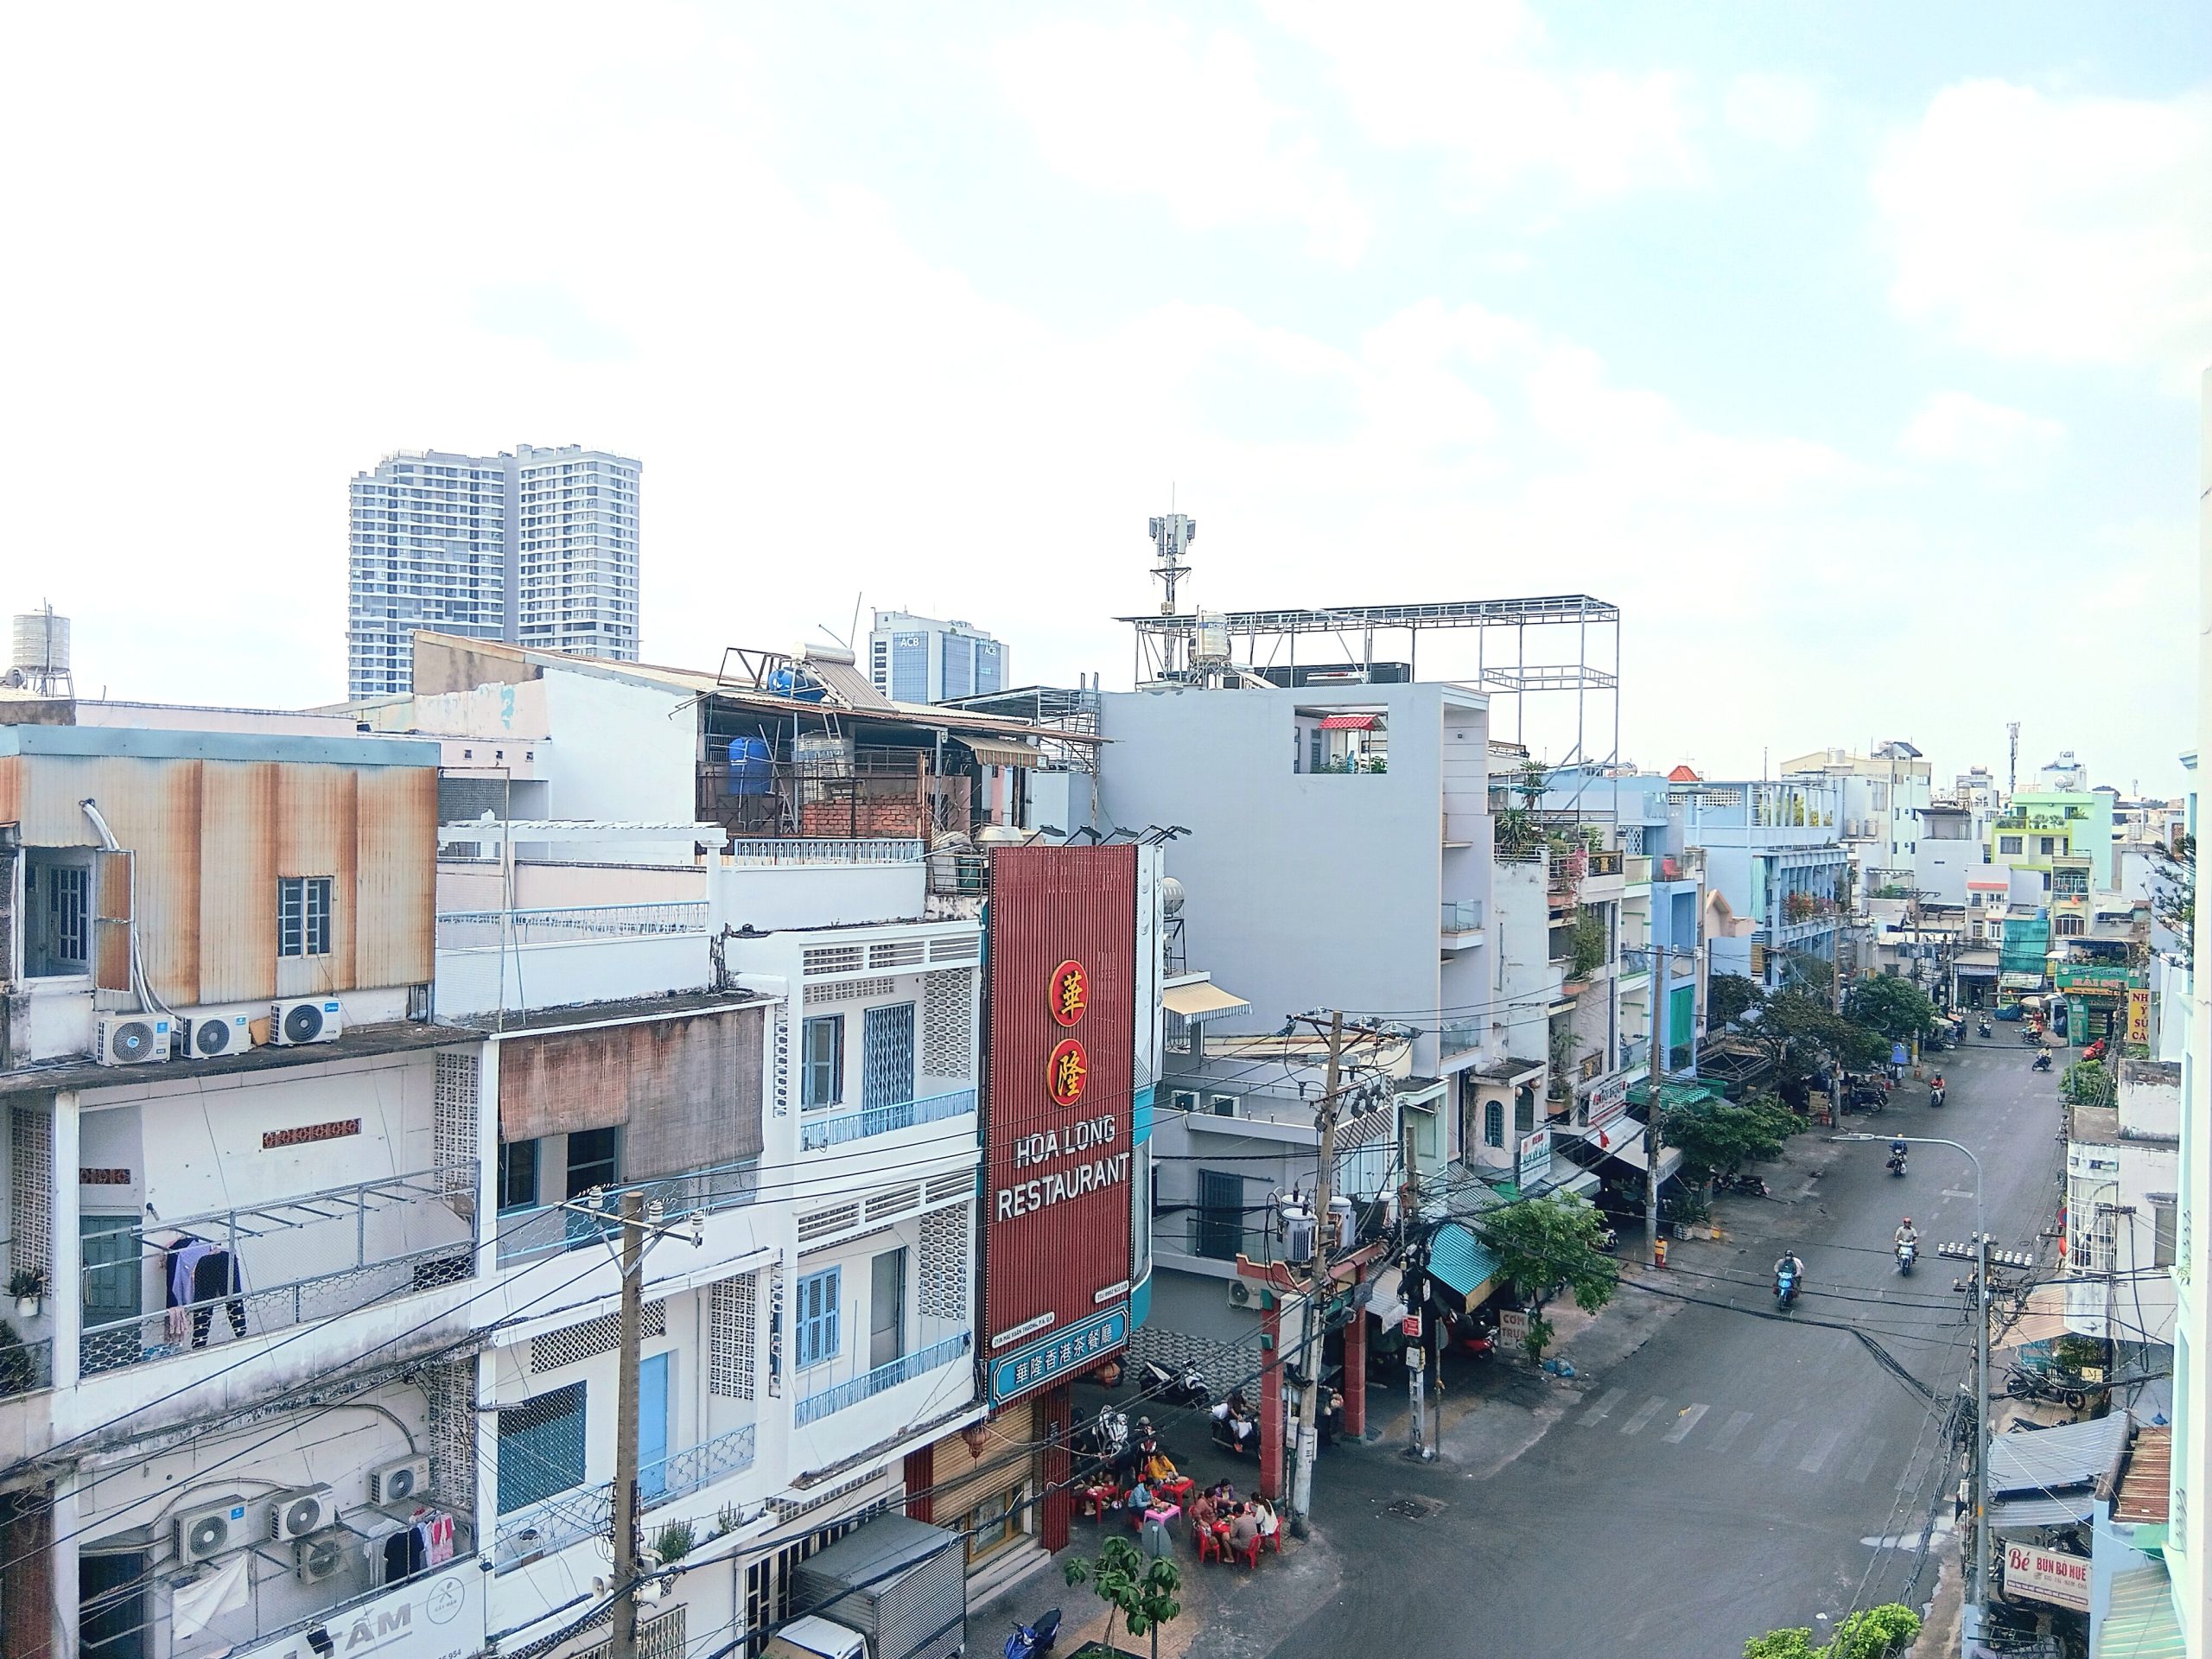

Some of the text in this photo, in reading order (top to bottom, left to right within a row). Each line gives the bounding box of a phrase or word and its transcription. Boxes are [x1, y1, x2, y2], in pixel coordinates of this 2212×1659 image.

[900, 637, 919, 647] ACB
[985, 646, 996, 656] ACB
[2133, 993, 2149, 1001] NH
[1014, 1115, 1116, 1169] HOA LONG
[996, 1152, 1130, 1222] RESTAURANT
[1015, 1323, 1112, 1384] 華隆香港茶餐廳
[2009, 1548, 2031, 1571] Bé
[2037, 1555, 2054, 1573] BÚN
[2069, 1564, 2088, 1581] HUẾ
